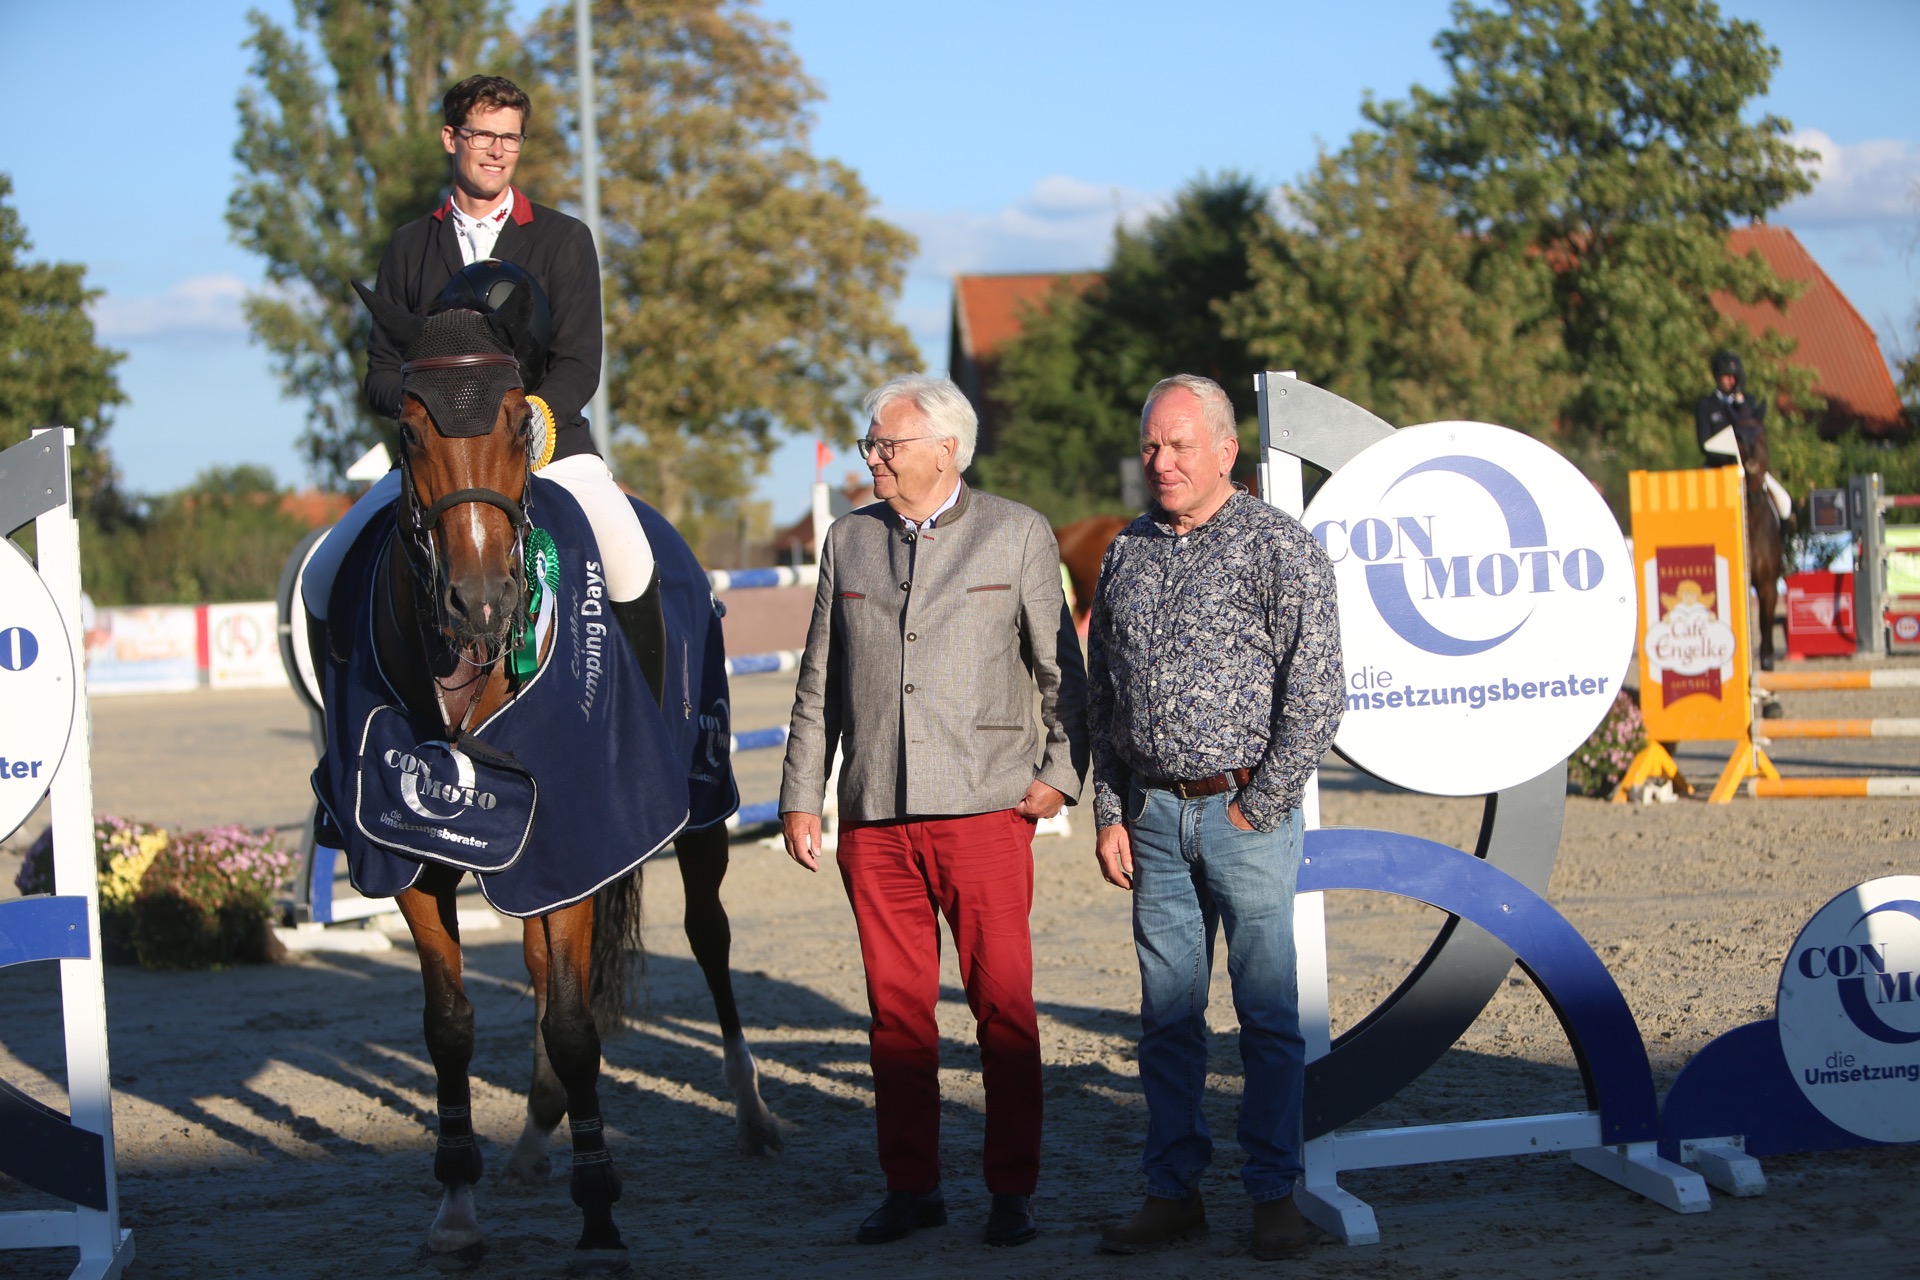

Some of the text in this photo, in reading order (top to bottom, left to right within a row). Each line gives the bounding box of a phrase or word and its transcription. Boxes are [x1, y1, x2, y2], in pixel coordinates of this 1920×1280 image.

[1311, 515, 1436, 564] CON
[581, 560, 606, 616] Days
[1420, 547, 1605, 600] MOTO
[1345, 673, 1609, 711] msetzungsberater
[1351, 665, 1393, 690] die
[384, 749, 433, 779] CON
[420, 776, 497, 810] MOTO
[380, 812, 488, 849] Umsetzungsberater
[1798, 942, 1888, 979] CON
[1875, 971, 1920, 1004] M
[1804, 1064, 1920, 1085] Umsetzung
[1825, 1051, 1856, 1069] die
